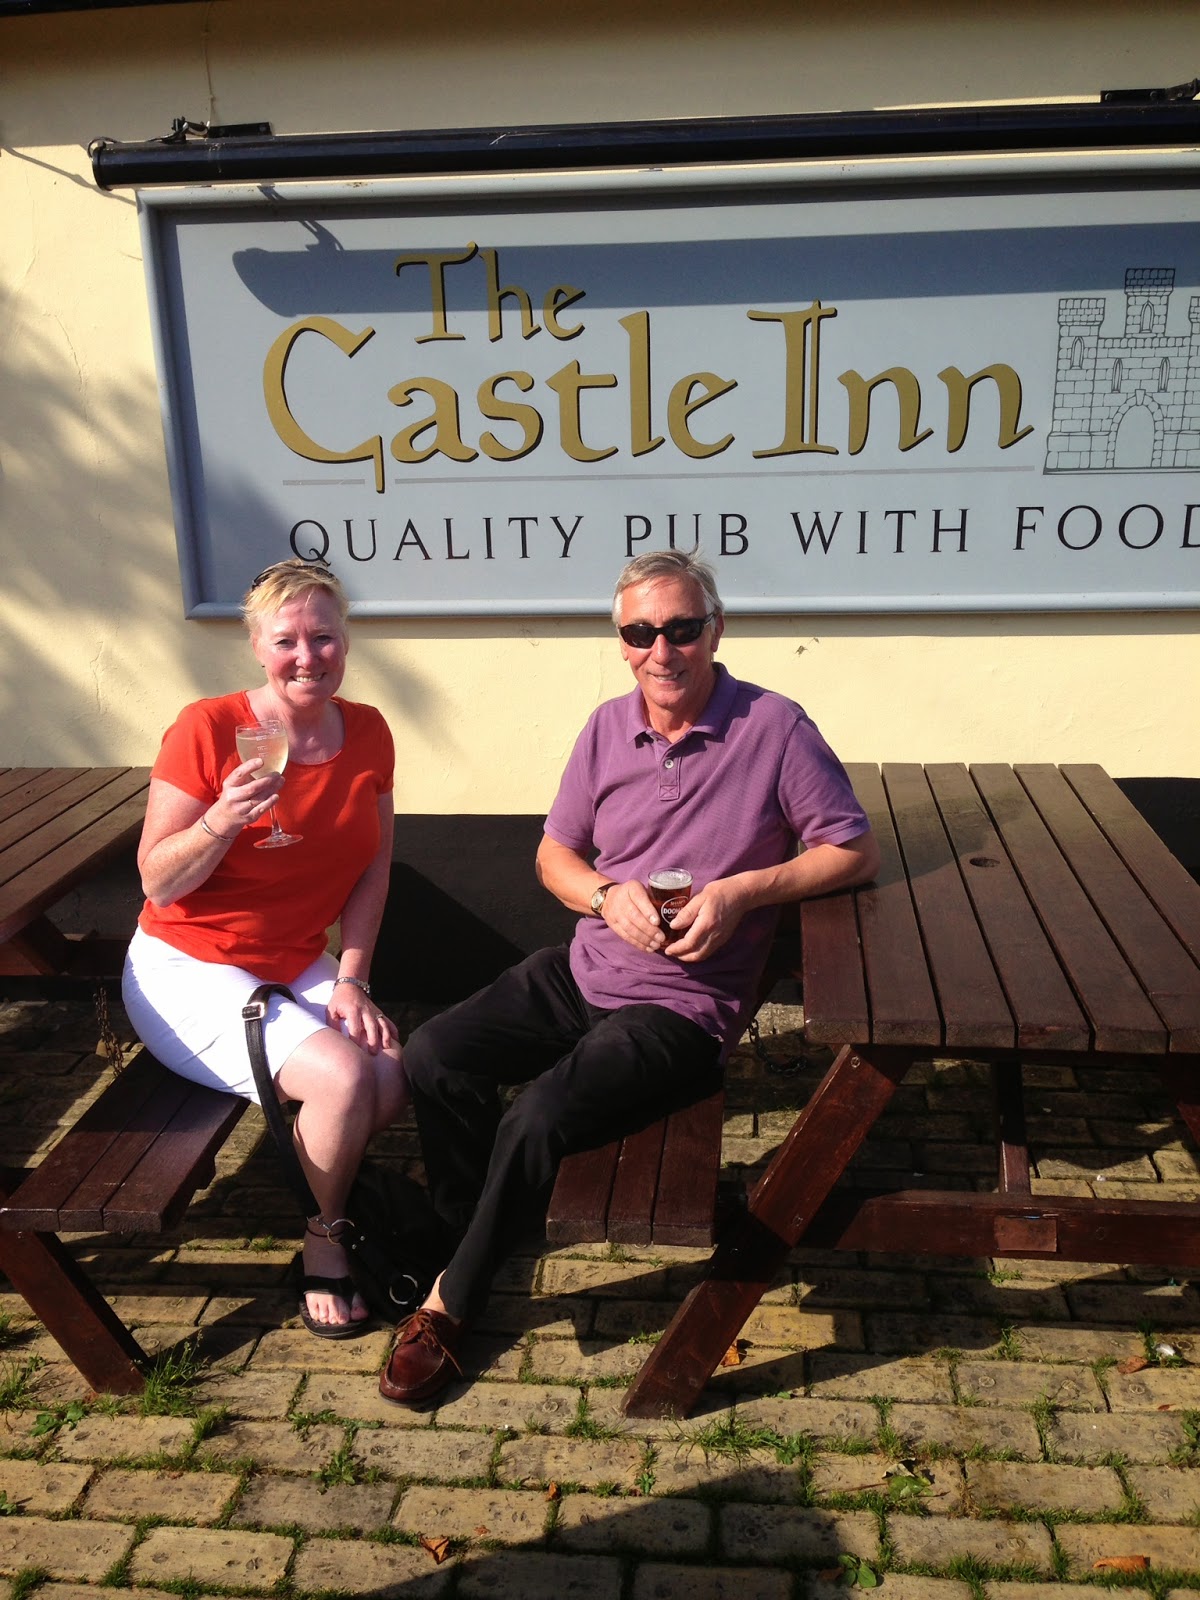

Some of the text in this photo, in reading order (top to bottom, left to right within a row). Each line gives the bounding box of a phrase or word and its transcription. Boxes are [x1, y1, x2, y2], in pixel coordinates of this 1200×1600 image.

[394, 241, 586, 344] The
[262, 299, 1035, 494] Castle Inn
[289, 514, 584, 567] QUALITY
[624, 512, 749, 557] PUB
[790, 508, 969, 555] WITH
